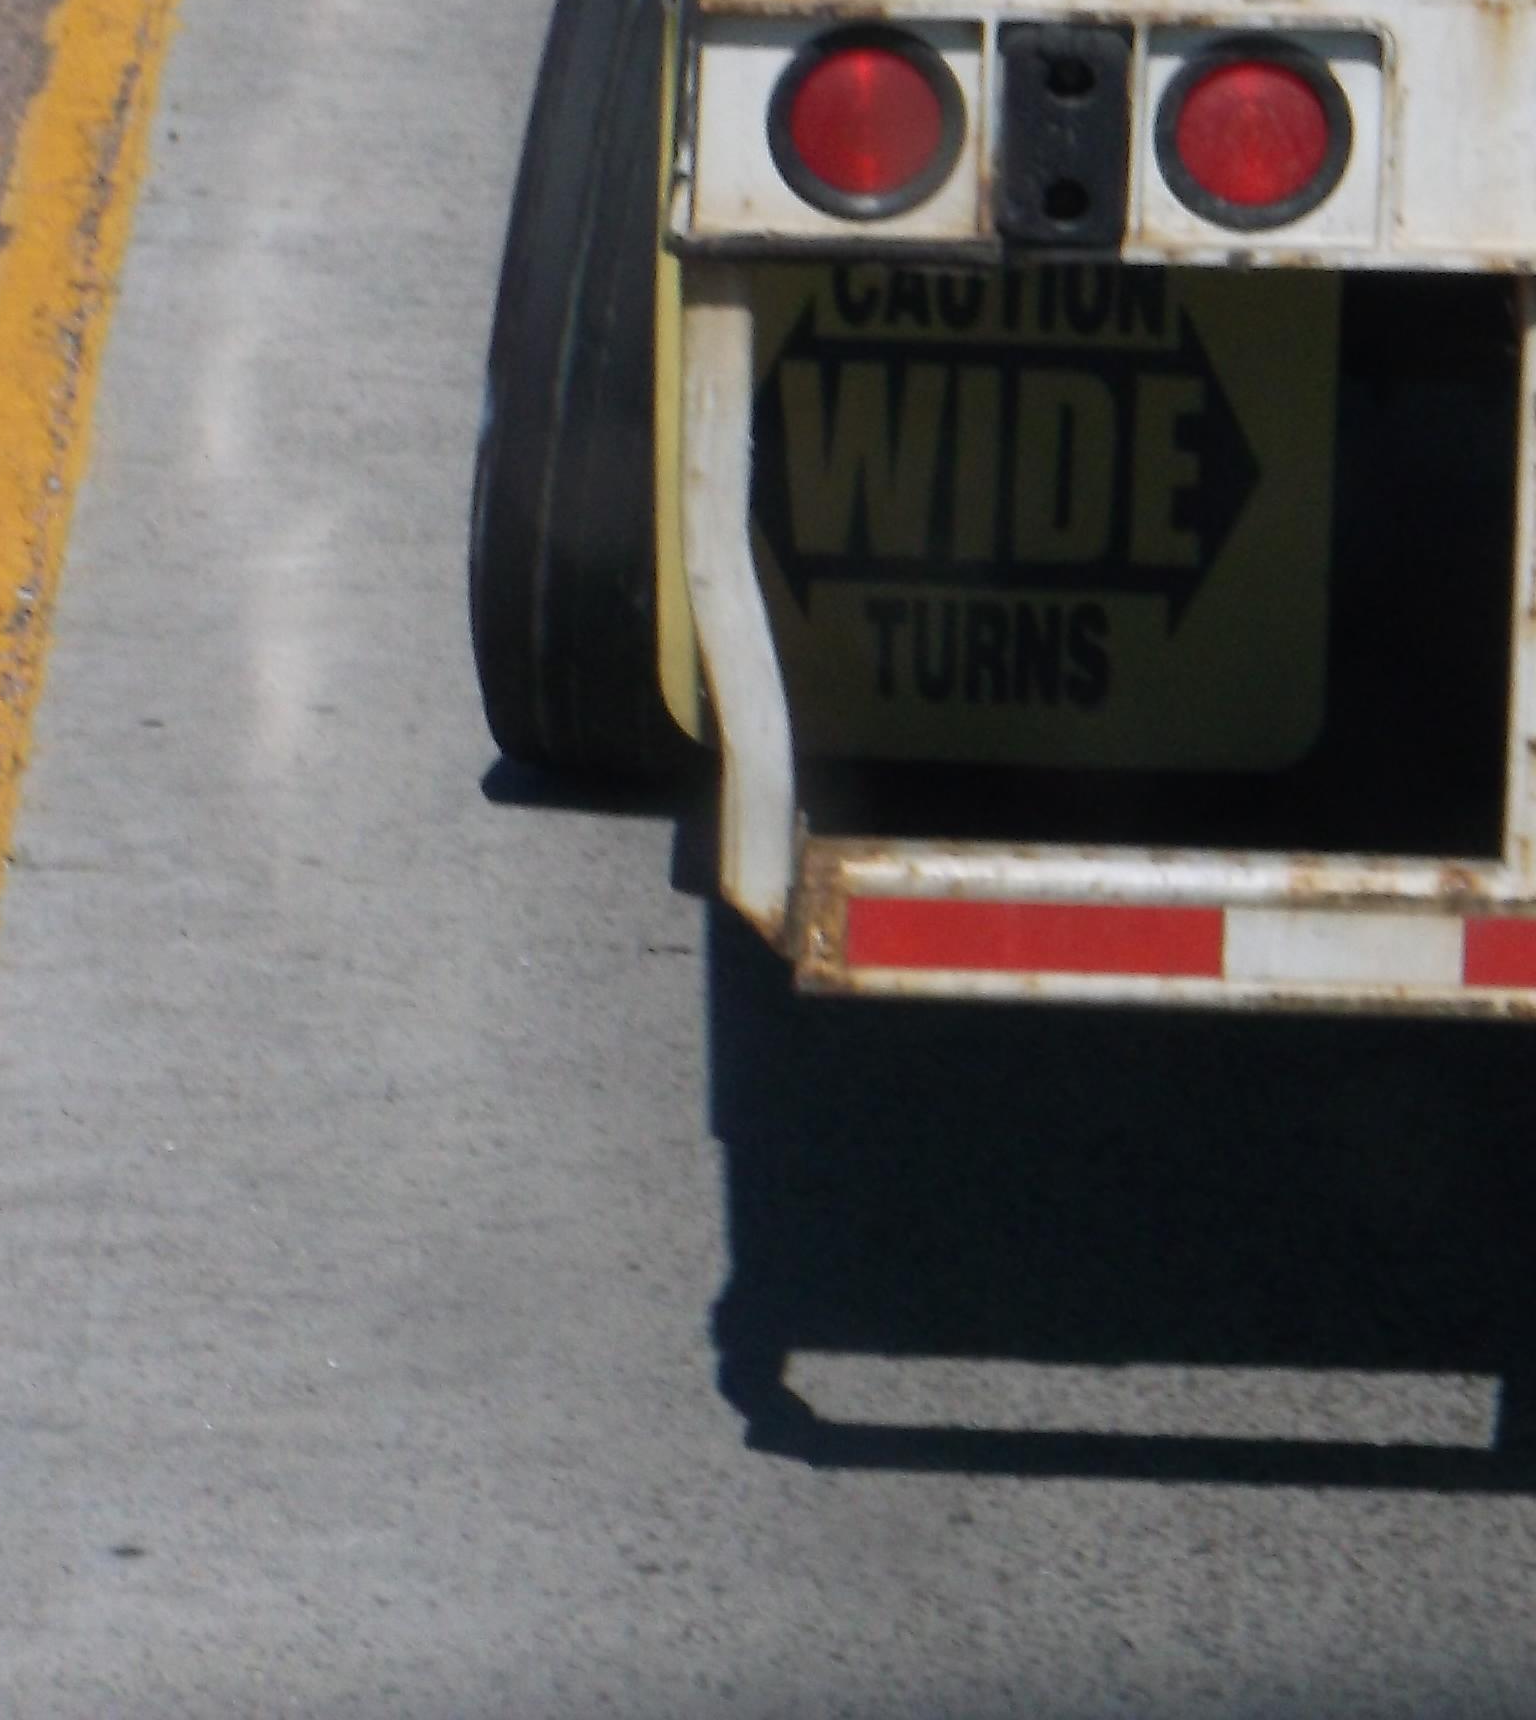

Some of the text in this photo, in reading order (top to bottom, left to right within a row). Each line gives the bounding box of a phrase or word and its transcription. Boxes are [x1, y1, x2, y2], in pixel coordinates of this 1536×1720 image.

[832, 264, 1167, 336] CAUTION
[778, 355, 1209, 569] WIDE
[864, 598, 1112, 707] TURNS
